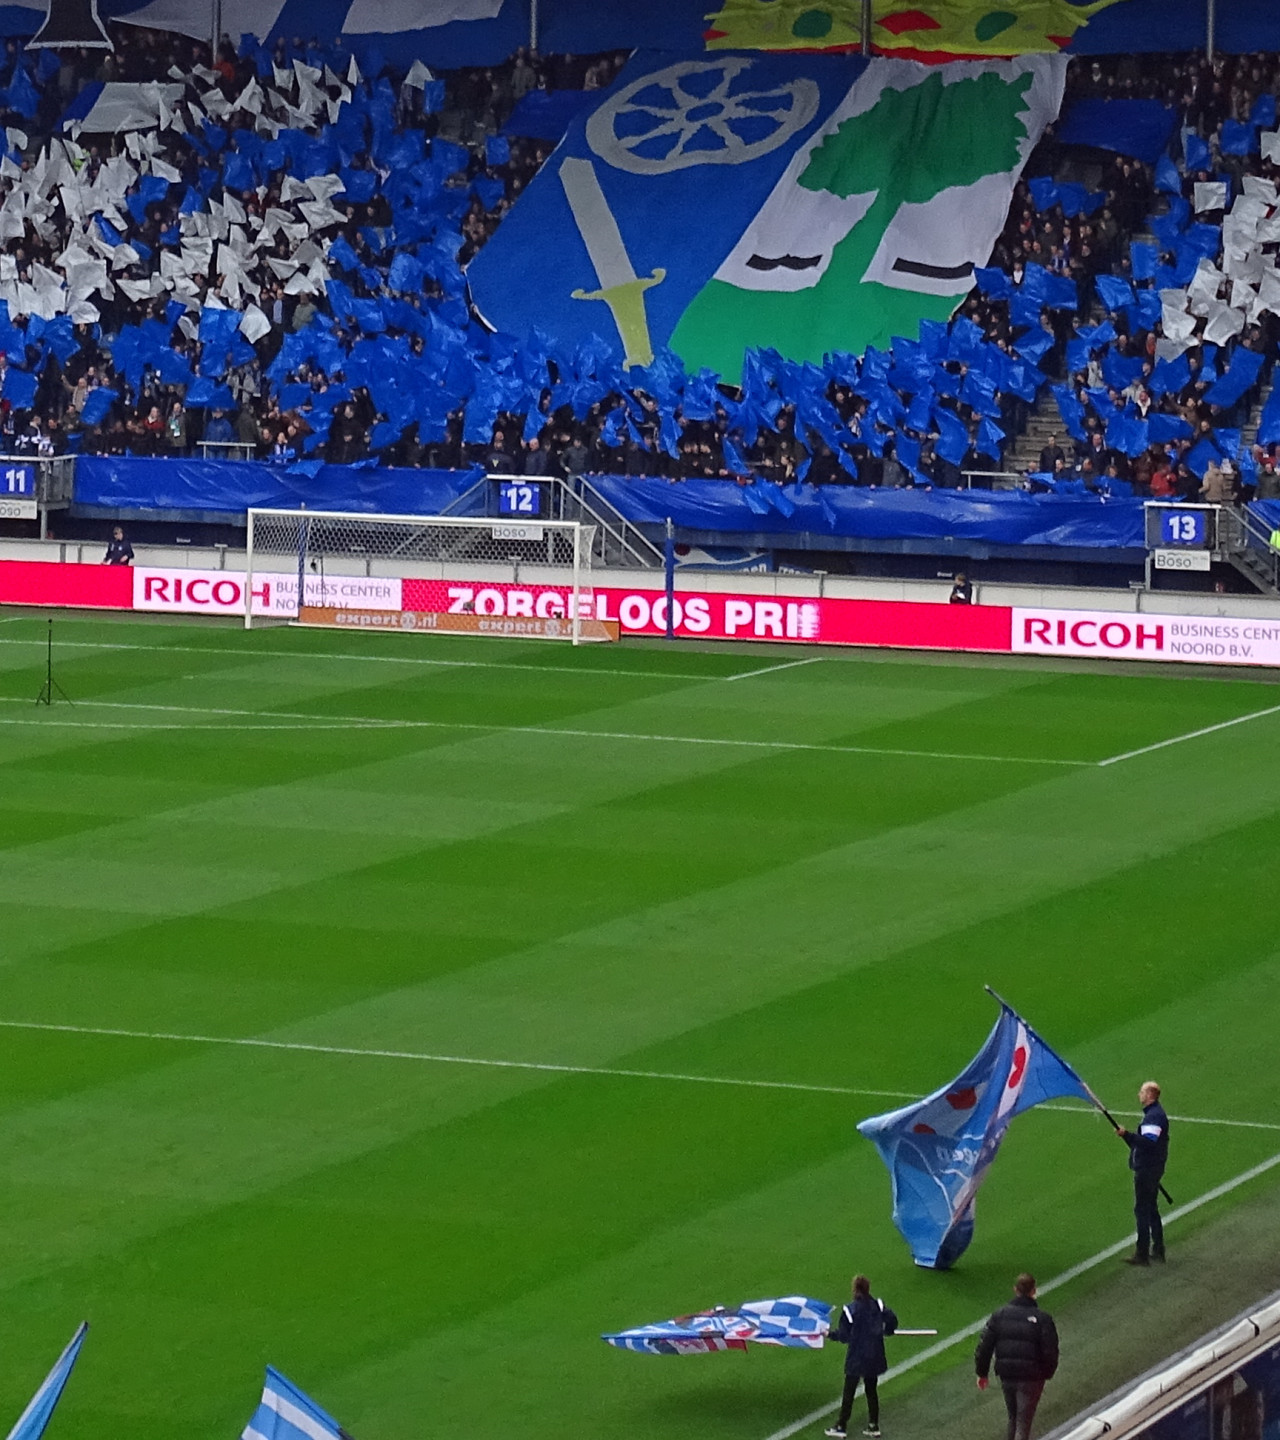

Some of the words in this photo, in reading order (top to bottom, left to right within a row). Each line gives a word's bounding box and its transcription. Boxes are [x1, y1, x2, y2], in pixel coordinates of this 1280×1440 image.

[5, 469, 26, 494] 11
[506, 486, 533, 512] 12
[1168, 515, 1197, 540] 13
[144, 576, 270, 607] RICOH
[276, 580, 340, 596] BUSNESS
[341, 584, 391, 599] CENTER
[335, 613, 398, 627] expert
[447, 587, 711, 632] ZORGELOOS
[478, 618, 542, 634] expert
[1024, 618, 1164, 650] RICOH
[1171, 624, 1239, 639] BUSINESS
[1171, 642, 1225, 656] NOORD
[1230, 644, 1254, 657] B.V.
